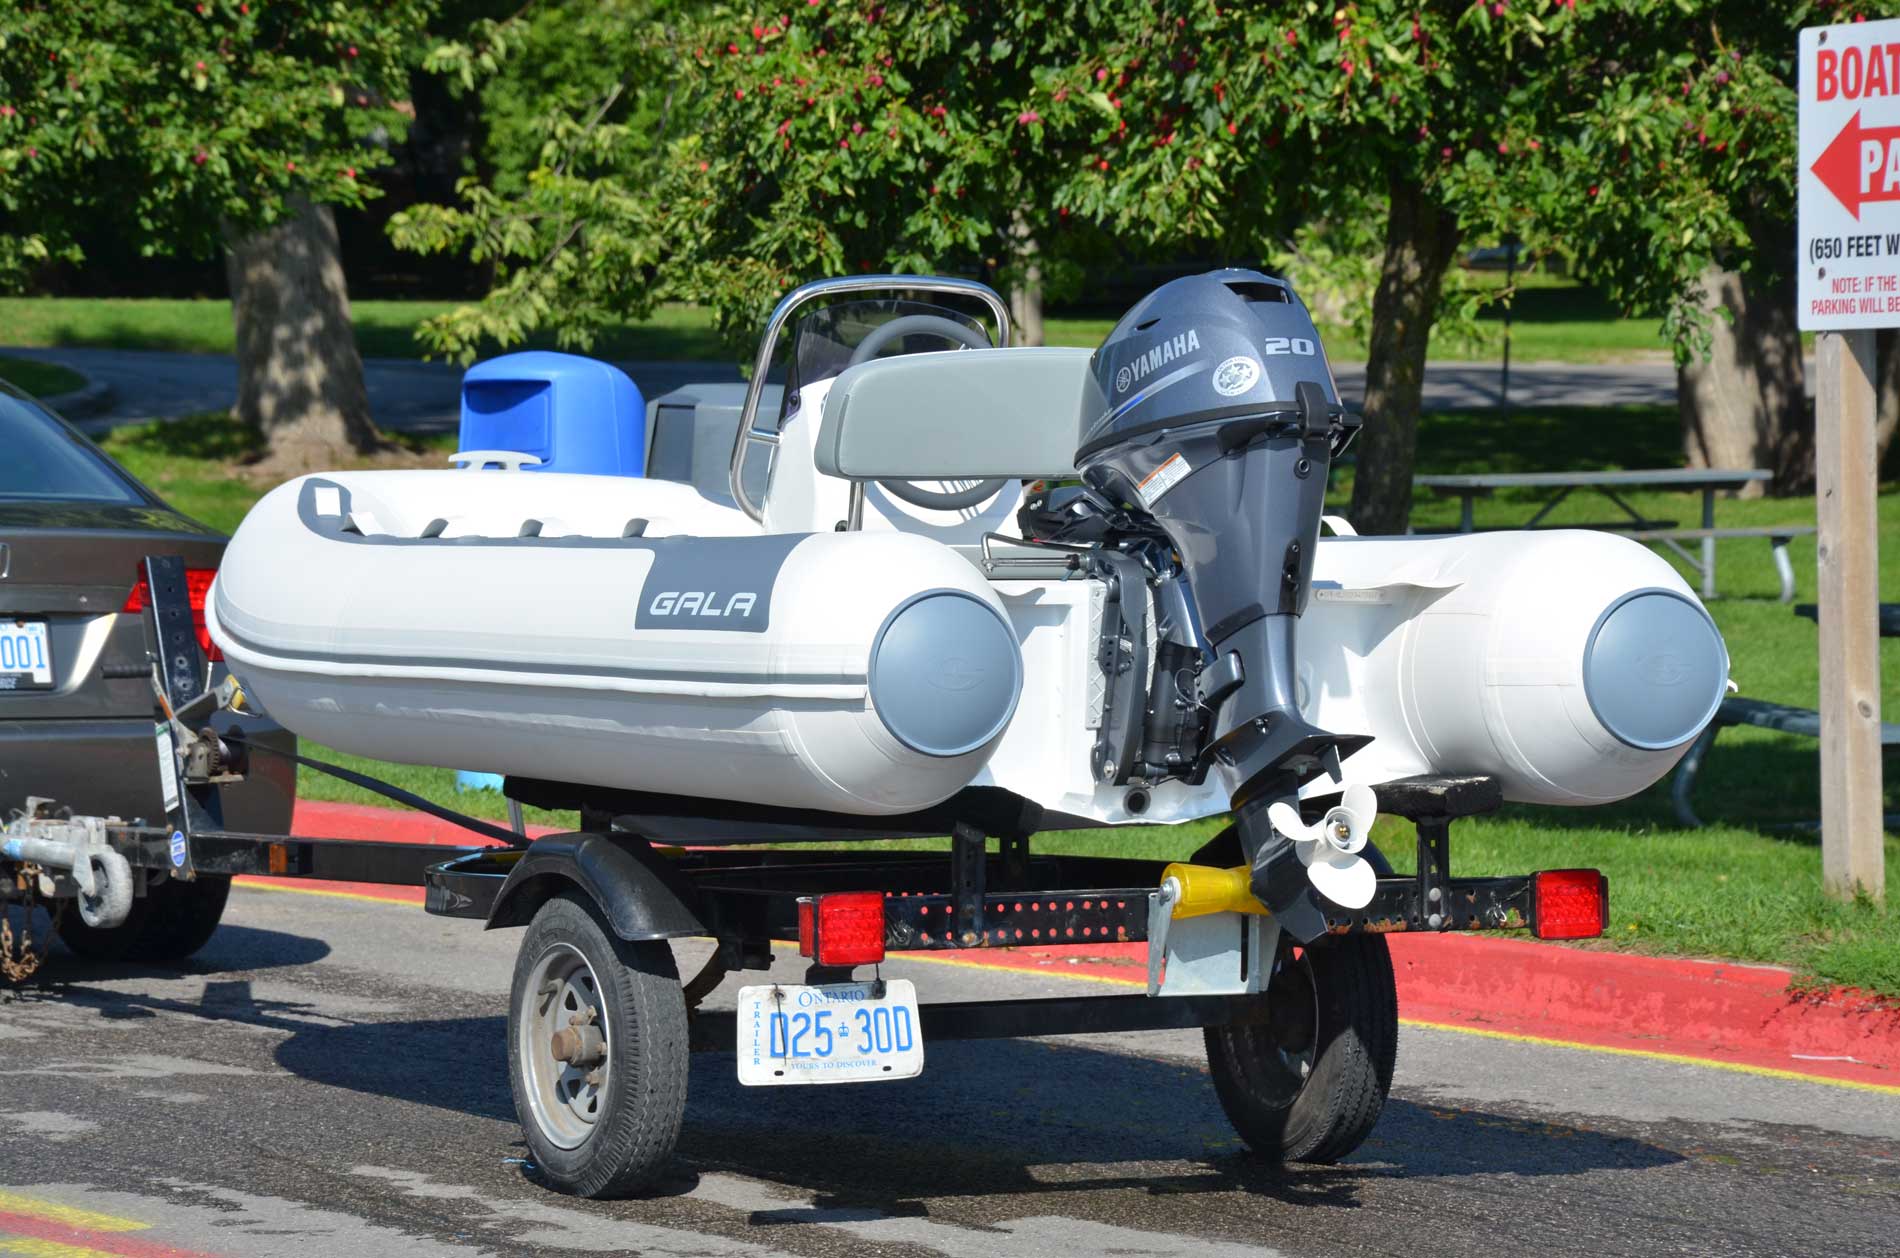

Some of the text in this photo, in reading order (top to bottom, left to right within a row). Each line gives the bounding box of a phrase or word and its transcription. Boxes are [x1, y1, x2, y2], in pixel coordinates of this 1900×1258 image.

[1817, 43, 1900, 101] BOAT
[1810, 237, 1842, 265] (650
[1847, 234, 1882, 258] FEET
[1832, 275, 1897, 294] NOTE: IF THE
[1811, 295, 1900, 316] PARKING WILL BE
[1131, 329, 1200, 382] YAMAHA
[1265, 337, 1315, 356] 20
[650, 591, 757, 617] GALA
[0, 635, 46, 669] 001
[753, 1001, 761, 1066] TRAILER
[770, 1005, 913, 1058] D25 30D
[791, 1059, 876, 1070] YOURS TO DISCOVER
